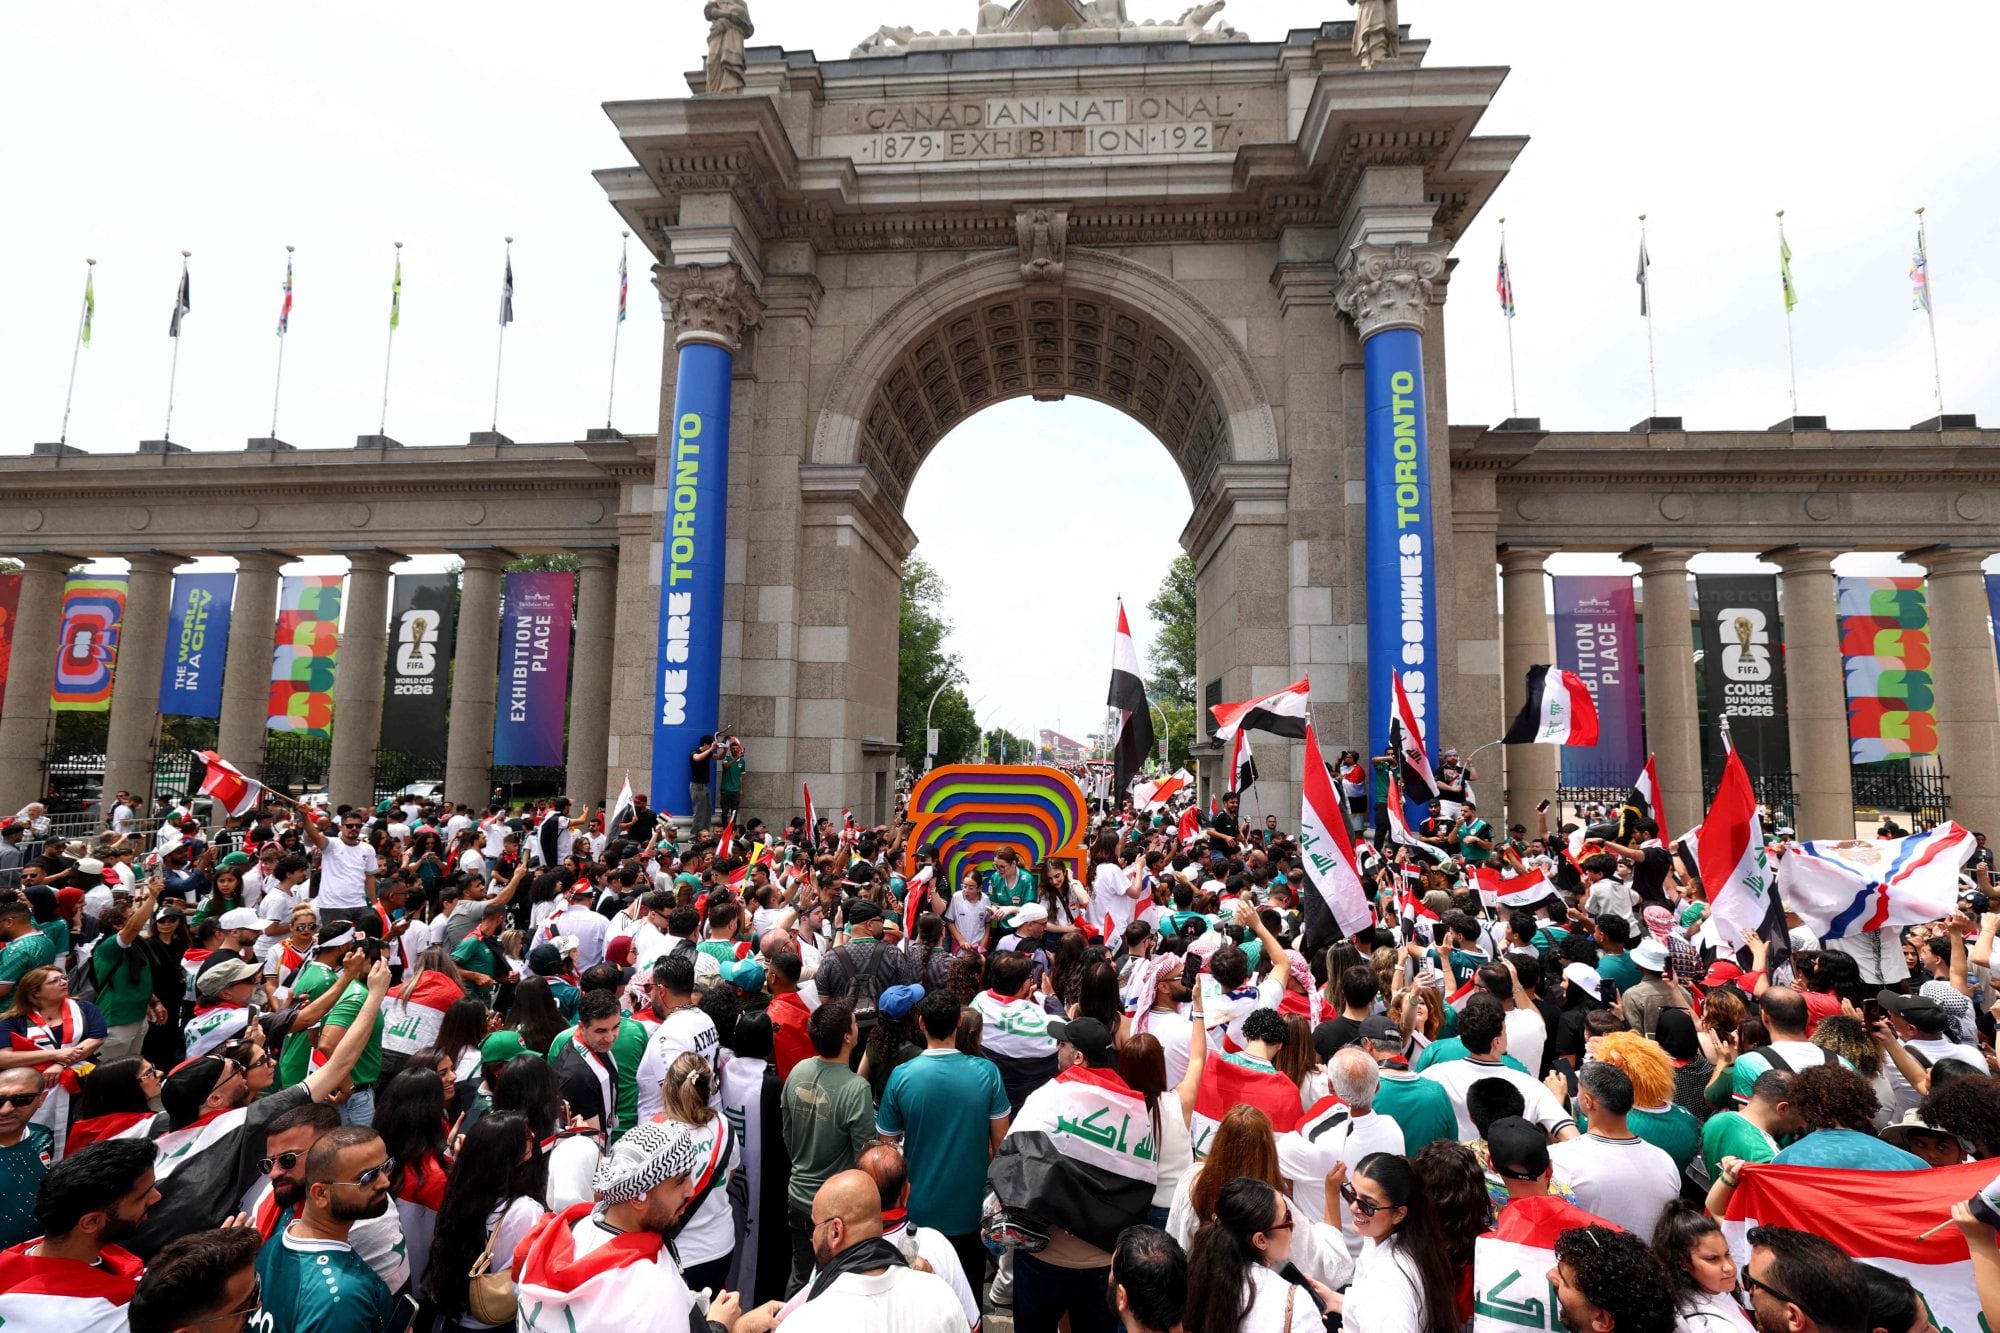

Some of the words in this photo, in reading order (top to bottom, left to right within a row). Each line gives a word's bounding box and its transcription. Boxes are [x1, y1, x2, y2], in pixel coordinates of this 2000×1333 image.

[866, 100, 1040, 130] CANADIAN
[1058, 95, 1234, 125] NATIONAL
[870, 136, 934, 160] 1879
[948, 128, 1147, 156] EXHIBITION
[1159, 124, 1231, 150] 1927
[1391, 370, 1420, 529] TORONTO
[670, 412, 702, 587] TORONTO
[1399, 533, 1425, 665] SOMMES
[178, 588, 200, 663] WORLD
[191, 589, 212, 651] CITY
[666, 592, 692, 663] ARE
[532, 615, 551, 672] PLACE
[1598, 623, 1620, 685] PLACE
[175, 666, 187, 690] THE
[189, 654, 201, 669] A
[406, 661, 424, 670] FIFA
[511, 615, 532, 722] EXHIBITION
[1737, 666, 1759, 675] FIFA
[186, 672, 199, 690] IN
[393, 685, 434, 695] 2026
[395, 677, 419, 685] WORLD
[419, 677, 434, 685] CUP
[663, 668, 688, 725] WE
[1724, 684, 1773, 696] COUPE
[1725, 696, 1739, 704] DU
[1739, 696, 1774, 705] MONDE
[1725, 705, 1774, 717] 2026
[694, 1026, 720, 1053] AYME
